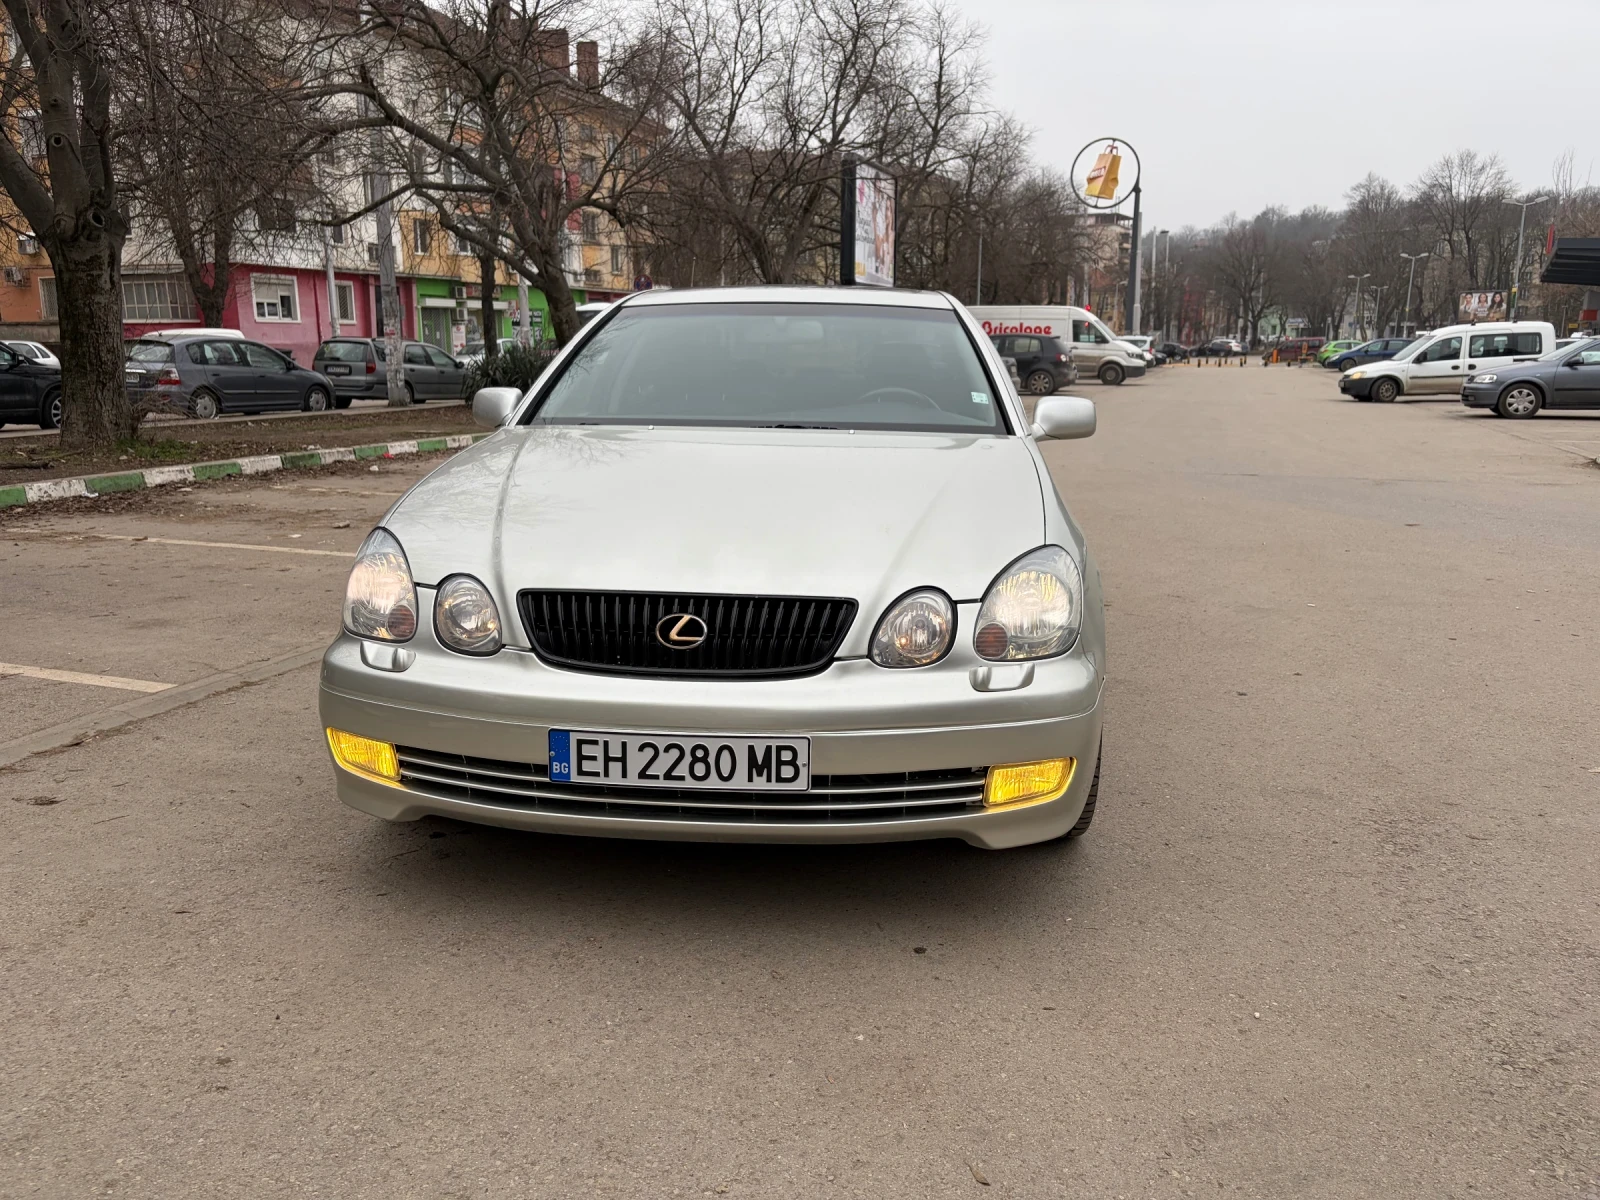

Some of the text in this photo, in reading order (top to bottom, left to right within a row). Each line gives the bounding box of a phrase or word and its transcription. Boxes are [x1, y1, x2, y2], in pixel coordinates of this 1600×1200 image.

[552, 761, 569, 774] BG
[576, 738, 800, 784] EH 2280 MB
